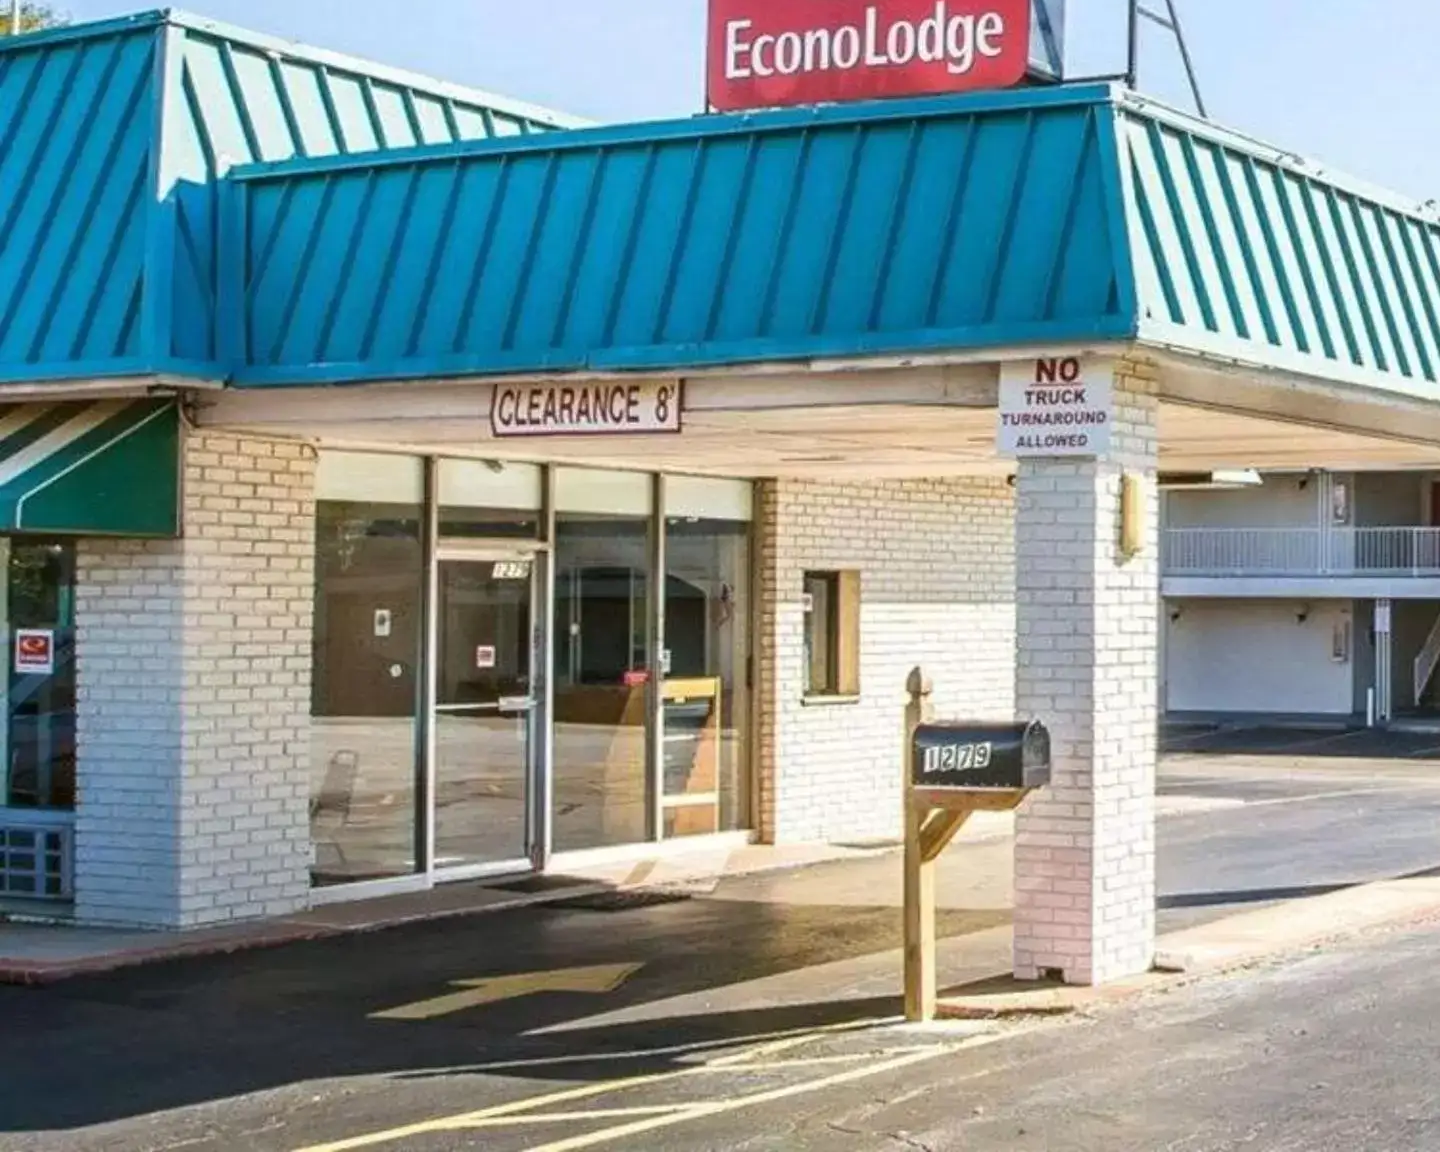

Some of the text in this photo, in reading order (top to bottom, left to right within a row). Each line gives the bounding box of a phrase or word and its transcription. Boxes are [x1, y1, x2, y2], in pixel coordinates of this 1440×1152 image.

[1035, 356, 1080, 383] NO
[499, 385, 641, 426] CLEARANCE
[1024, 389, 1087, 405] TRUCK
[1001, 410, 1108, 427] TURNAROUND
[1015, 434, 1089, 448] ALLOWED
[923, 741, 992, 773] 1279
